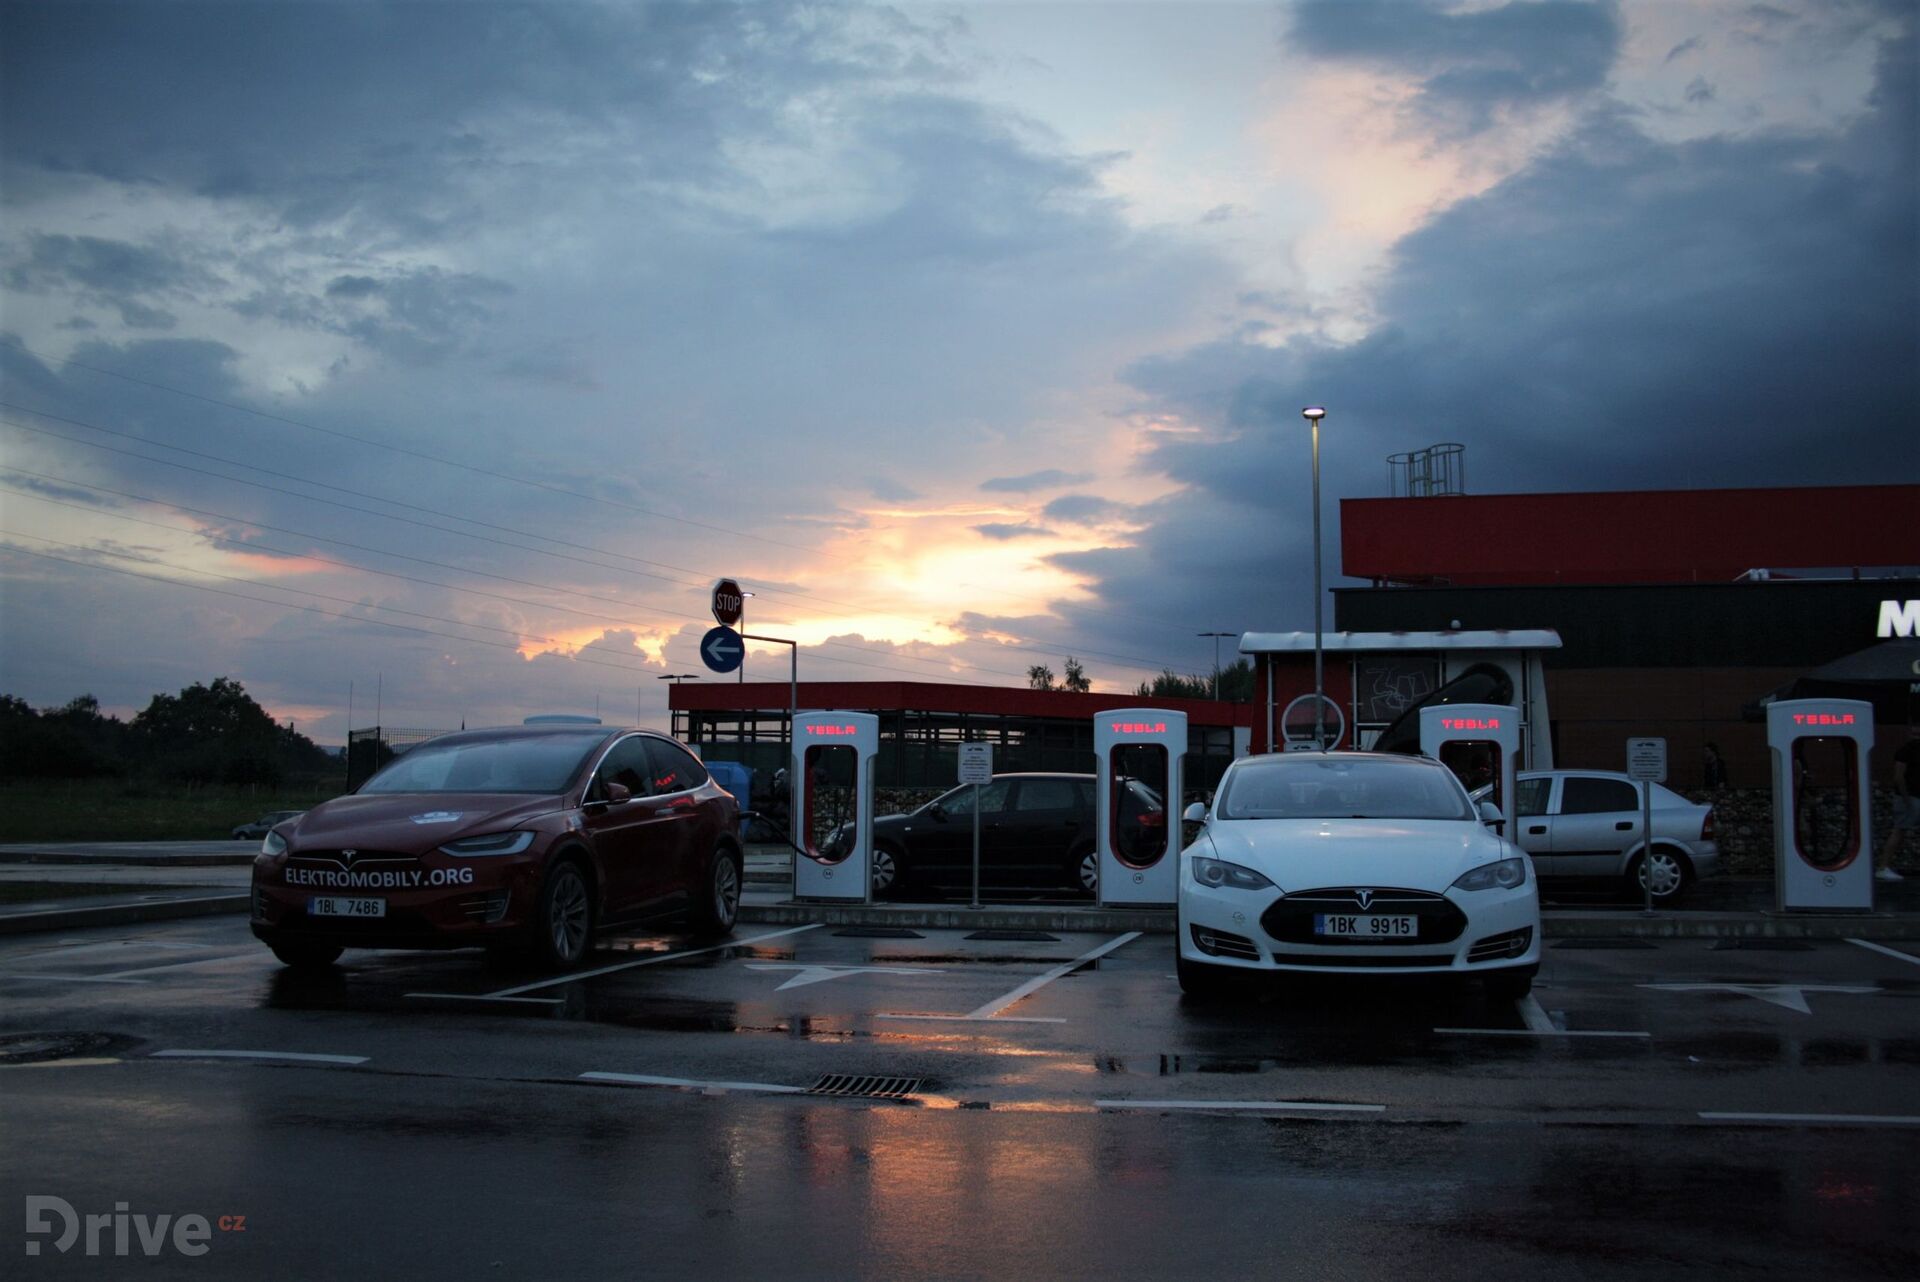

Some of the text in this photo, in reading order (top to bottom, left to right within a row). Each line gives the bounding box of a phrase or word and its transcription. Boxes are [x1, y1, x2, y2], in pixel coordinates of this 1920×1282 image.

[716, 593, 741, 612] STOP
[1441, 719, 1500, 729] TESLA
[1793, 713, 1856, 725] TESLA
[806, 725, 856, 735] TESLA
[1111, 722, 1167, 733] TESLA
[284, 867, 474, 889] ELEKTROMOBILY.ORG
[317, 899, 379, 915] 1BL 7486
[1328, 917, 1410, 934] 1BK 9915
